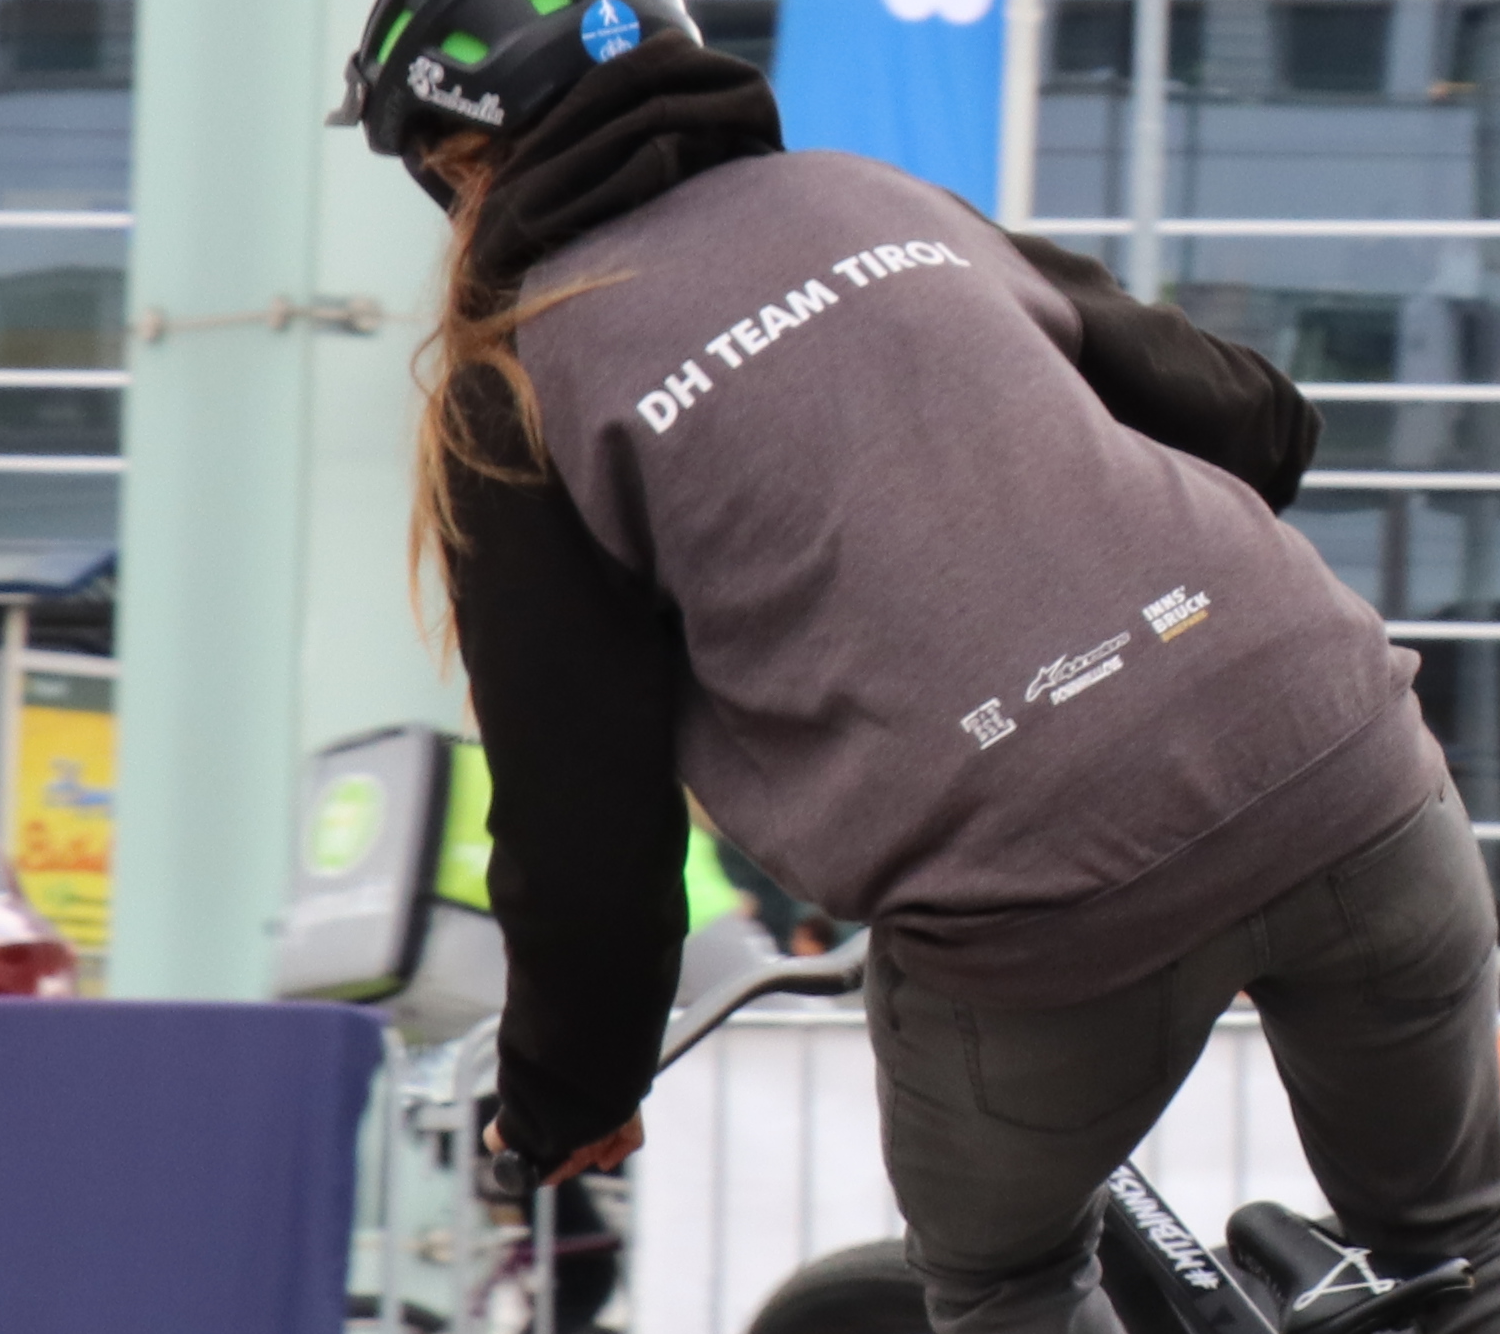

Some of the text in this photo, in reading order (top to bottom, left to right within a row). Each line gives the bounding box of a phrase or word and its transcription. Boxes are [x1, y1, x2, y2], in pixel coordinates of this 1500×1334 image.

[636, 240, 971, 434] DH TEAM TIROL
[1151, 591, 1212, 634] BRUCK
